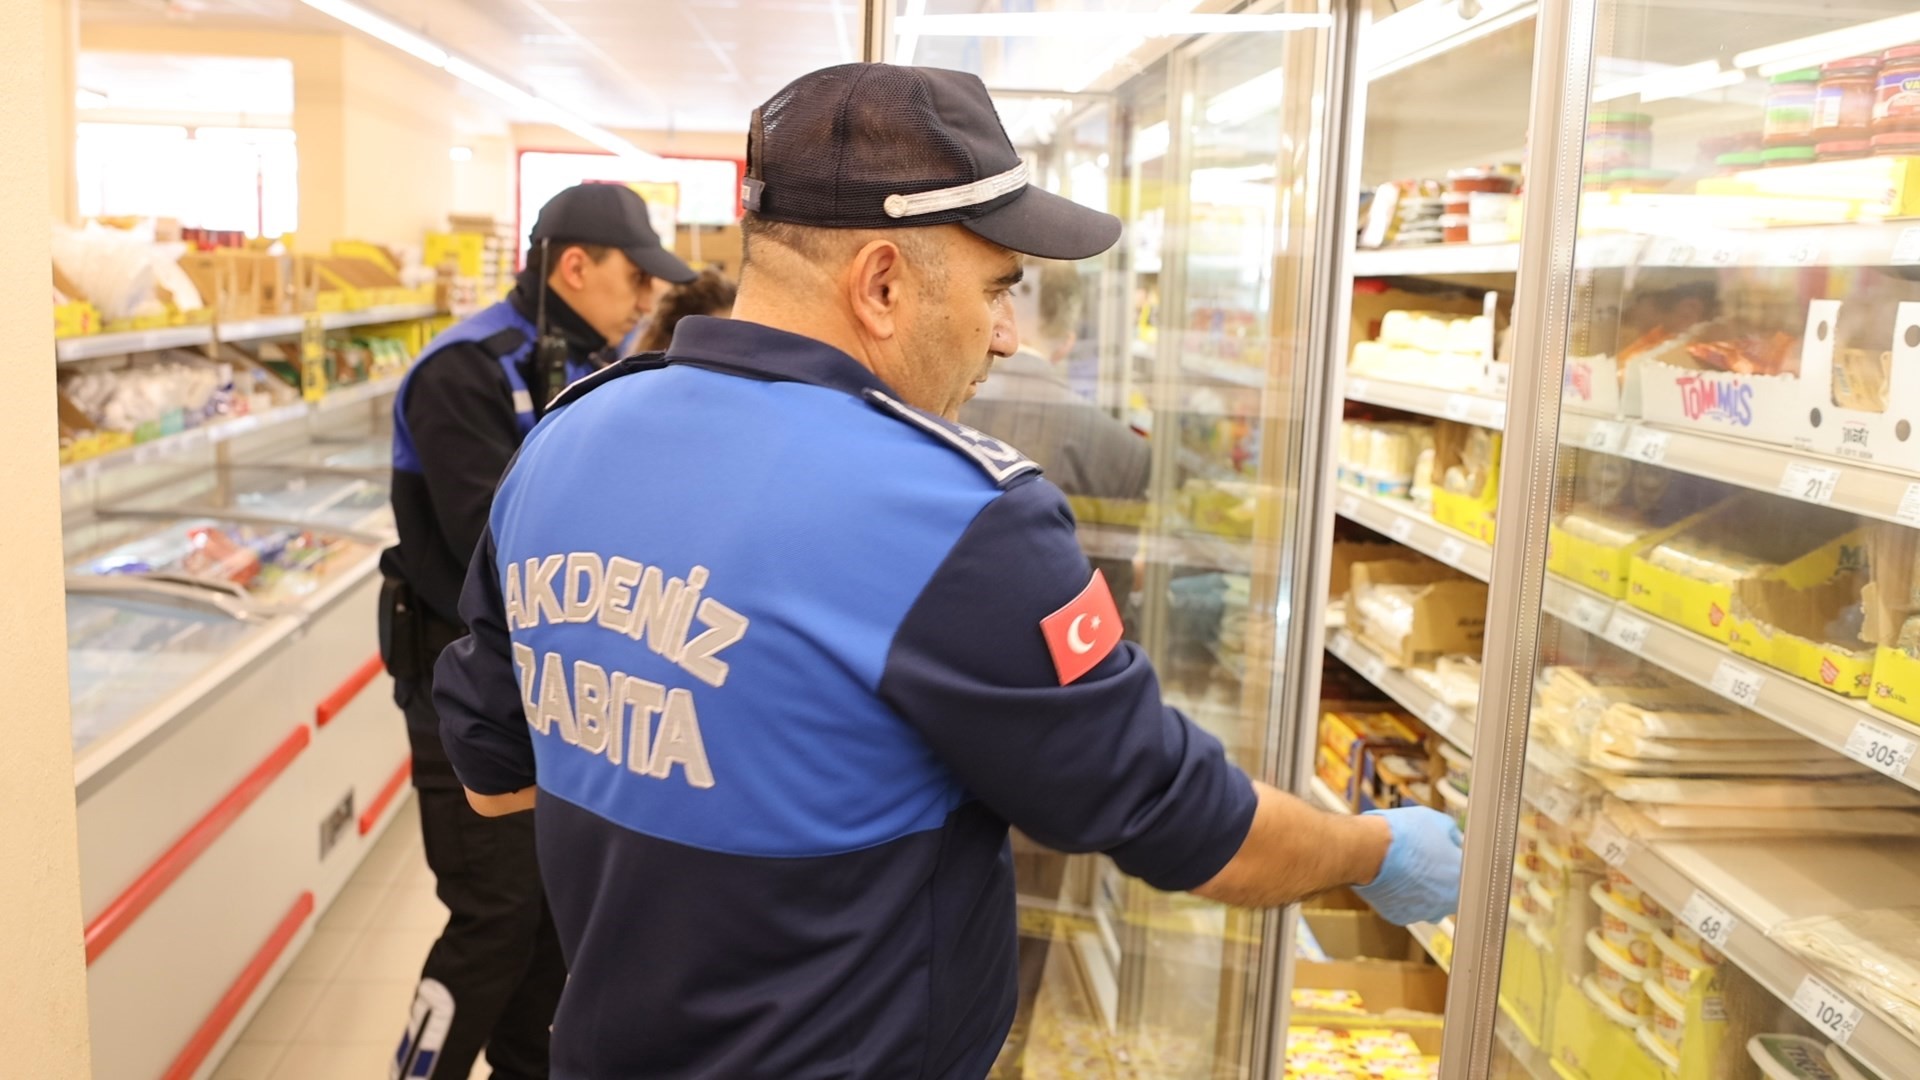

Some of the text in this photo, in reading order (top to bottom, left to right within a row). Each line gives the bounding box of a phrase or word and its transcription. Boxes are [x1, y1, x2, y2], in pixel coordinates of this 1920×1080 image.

[1803, 477, 1823, 500] 21
[505, 551, 750, 688] AKDENİZ
[1731, 678, 1751, 699] 155
[512, 640, 716, 789] ZABITA
[1866, 740, 1898, 767] 305
[1699, 915, 1721, 940] 68
[1816, 1000, 1844, 1032] 102
